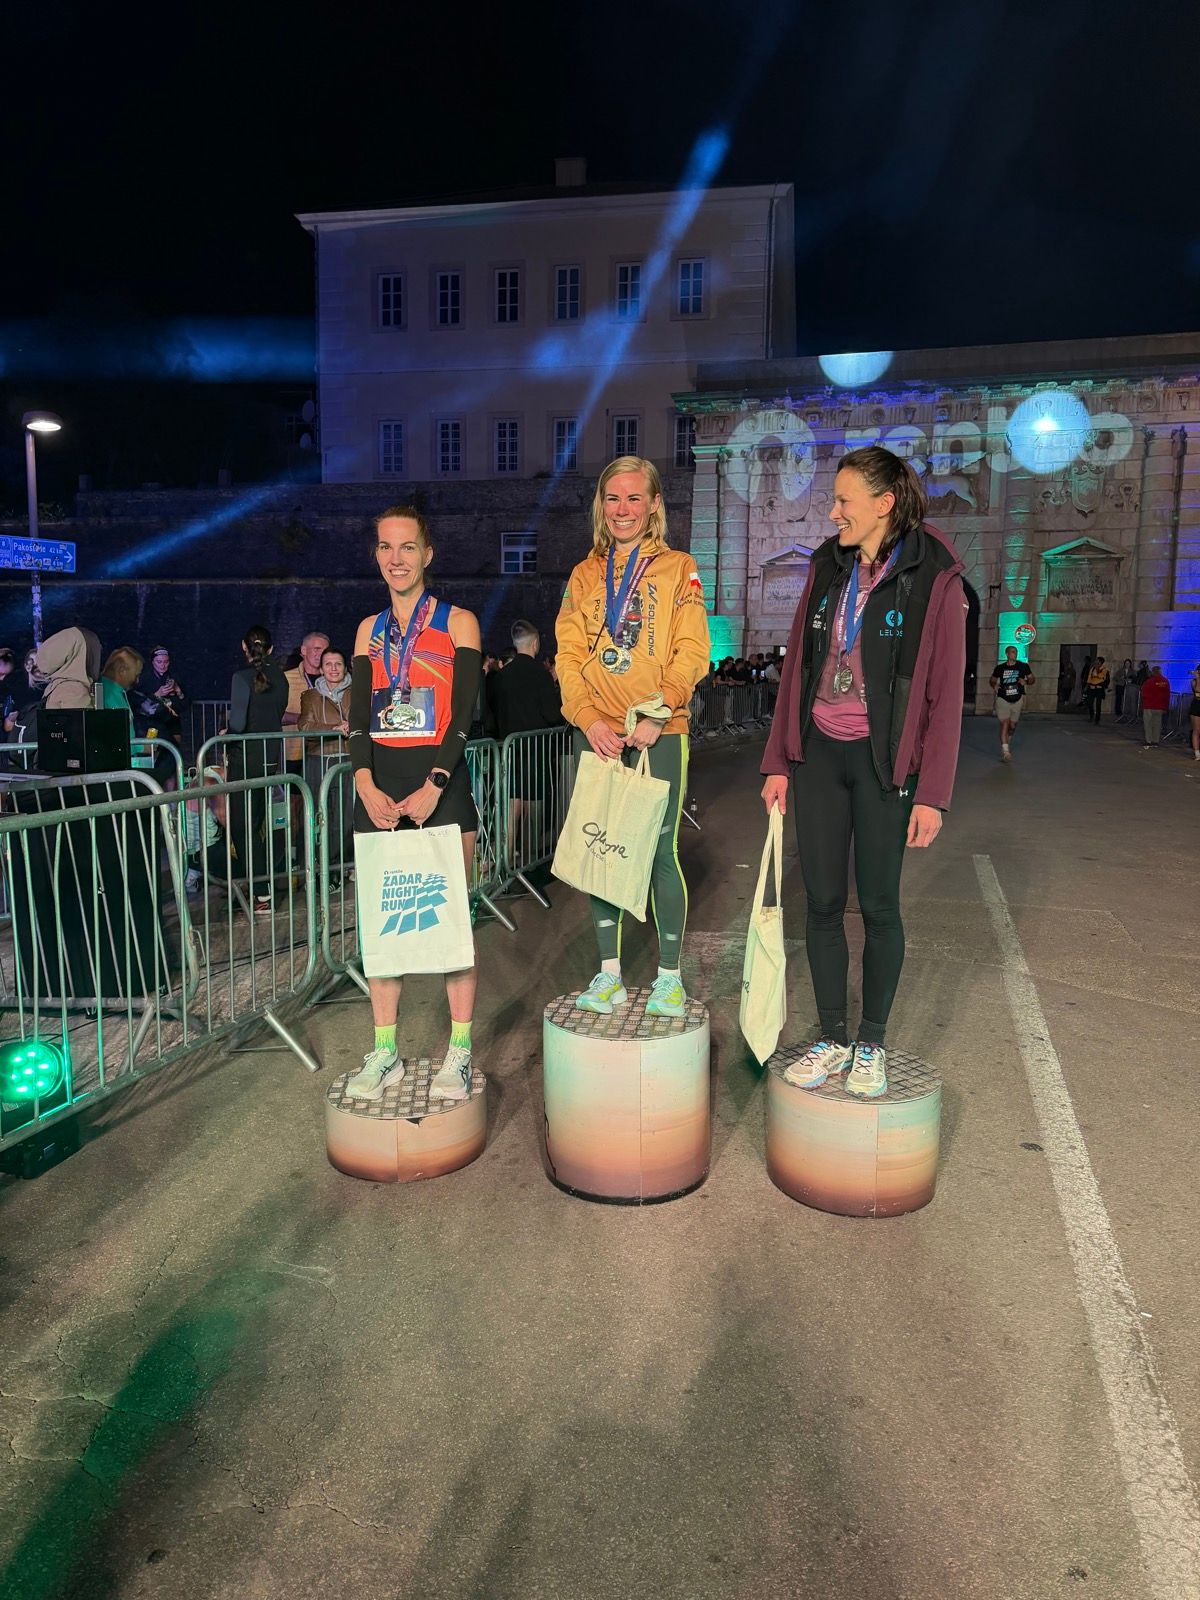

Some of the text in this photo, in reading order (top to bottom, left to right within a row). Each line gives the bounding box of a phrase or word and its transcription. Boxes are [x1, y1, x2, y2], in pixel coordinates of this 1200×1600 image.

[648, 605, 656, 657] SOLUTIONS
[383, 873, 423, 887] ZADAR
[382, 885, 419, 899] NIGHT
[381, 898, 406, 912] RUN
